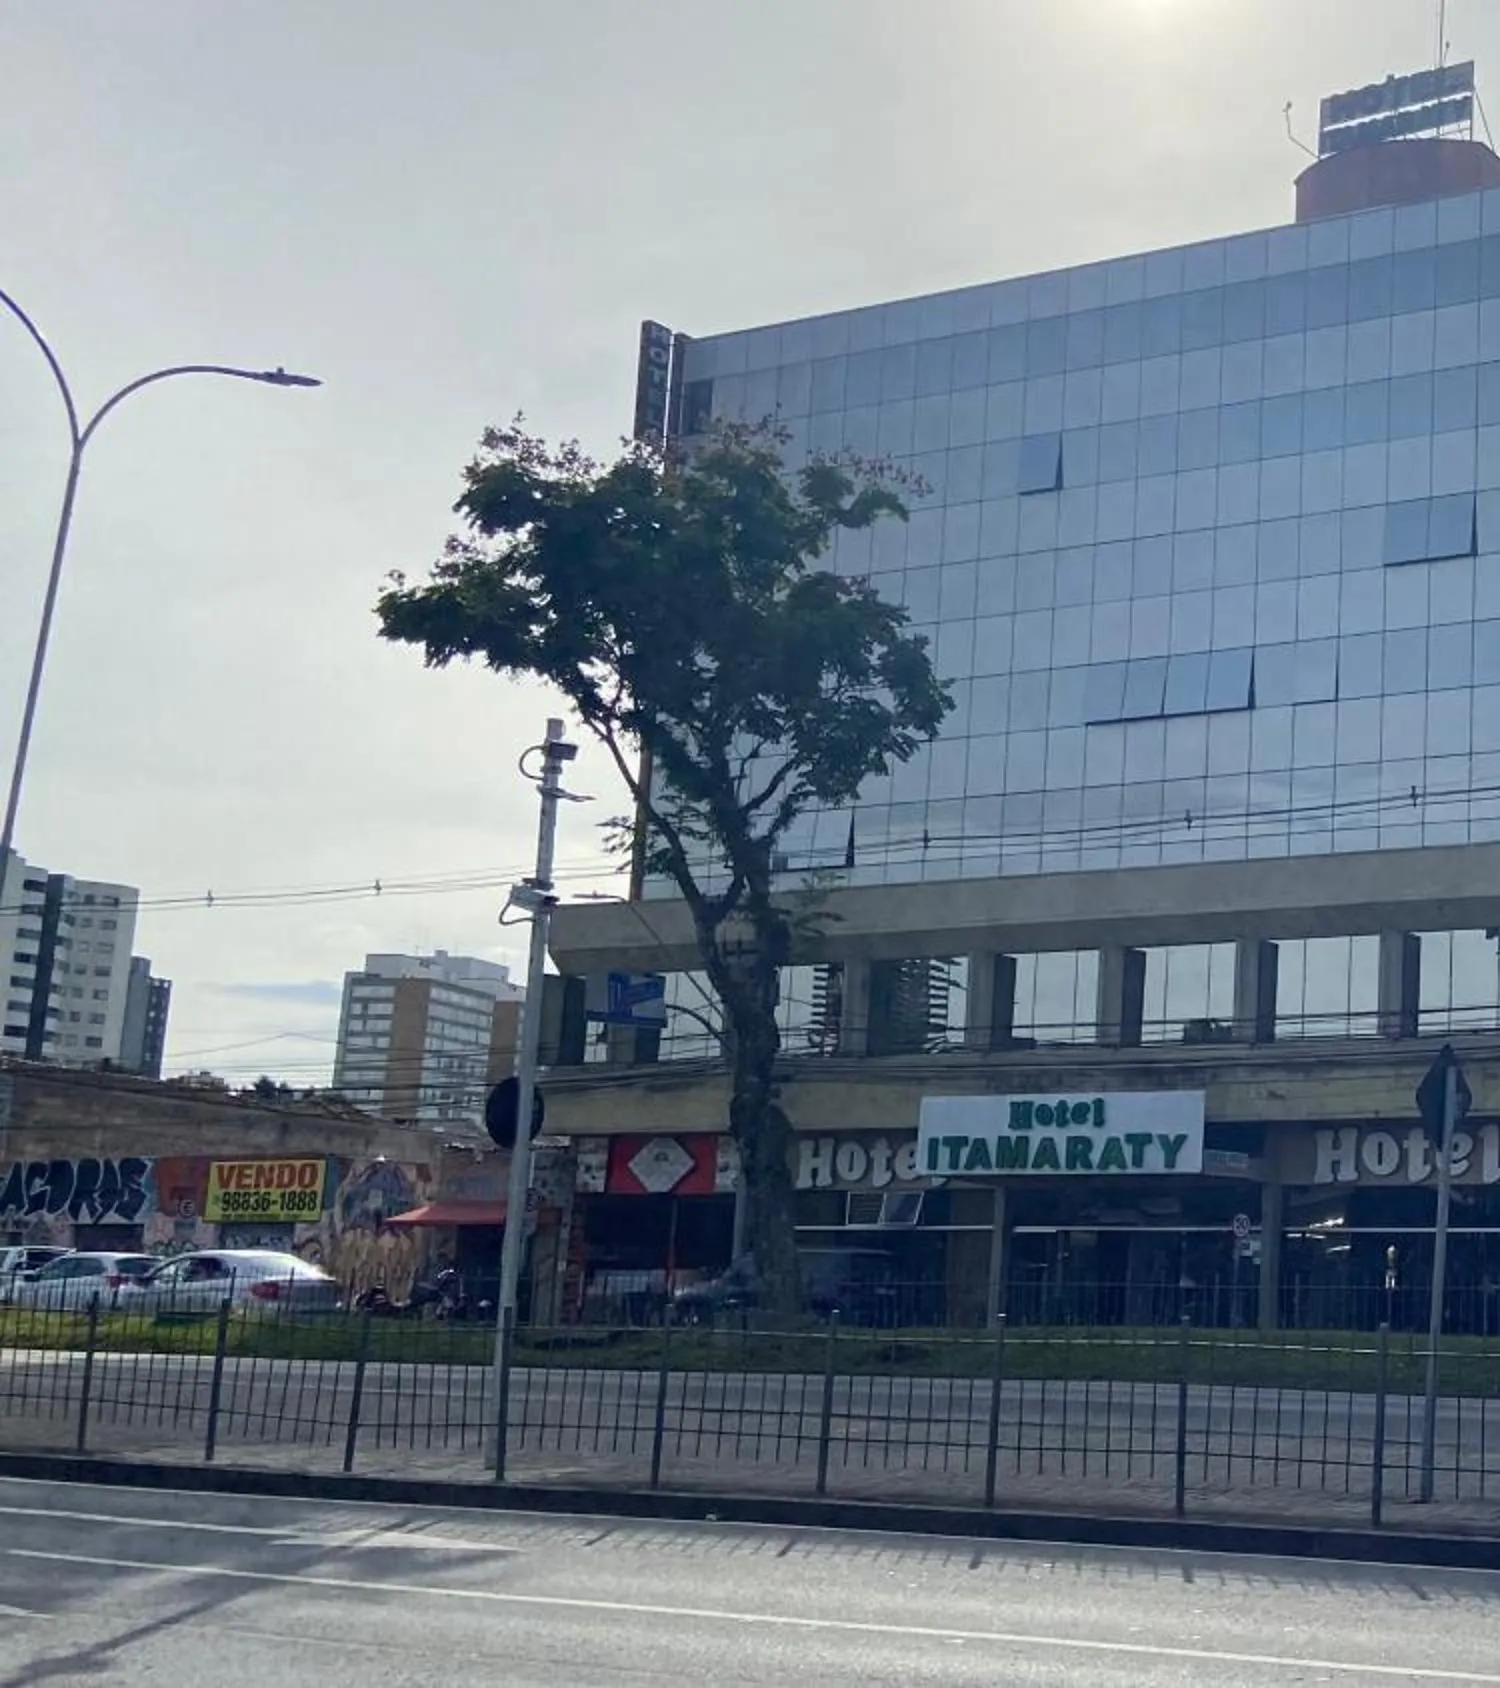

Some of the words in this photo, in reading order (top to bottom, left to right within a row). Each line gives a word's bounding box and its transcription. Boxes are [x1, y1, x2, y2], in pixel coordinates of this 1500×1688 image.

[1008, 1098, 1106, 1130] Hotel
[796, 1134, 947, 1189] Hote
[926, 1133, 1188, 1171] ITAMARATY
[217, 1163, 319, 1190] VENDO
